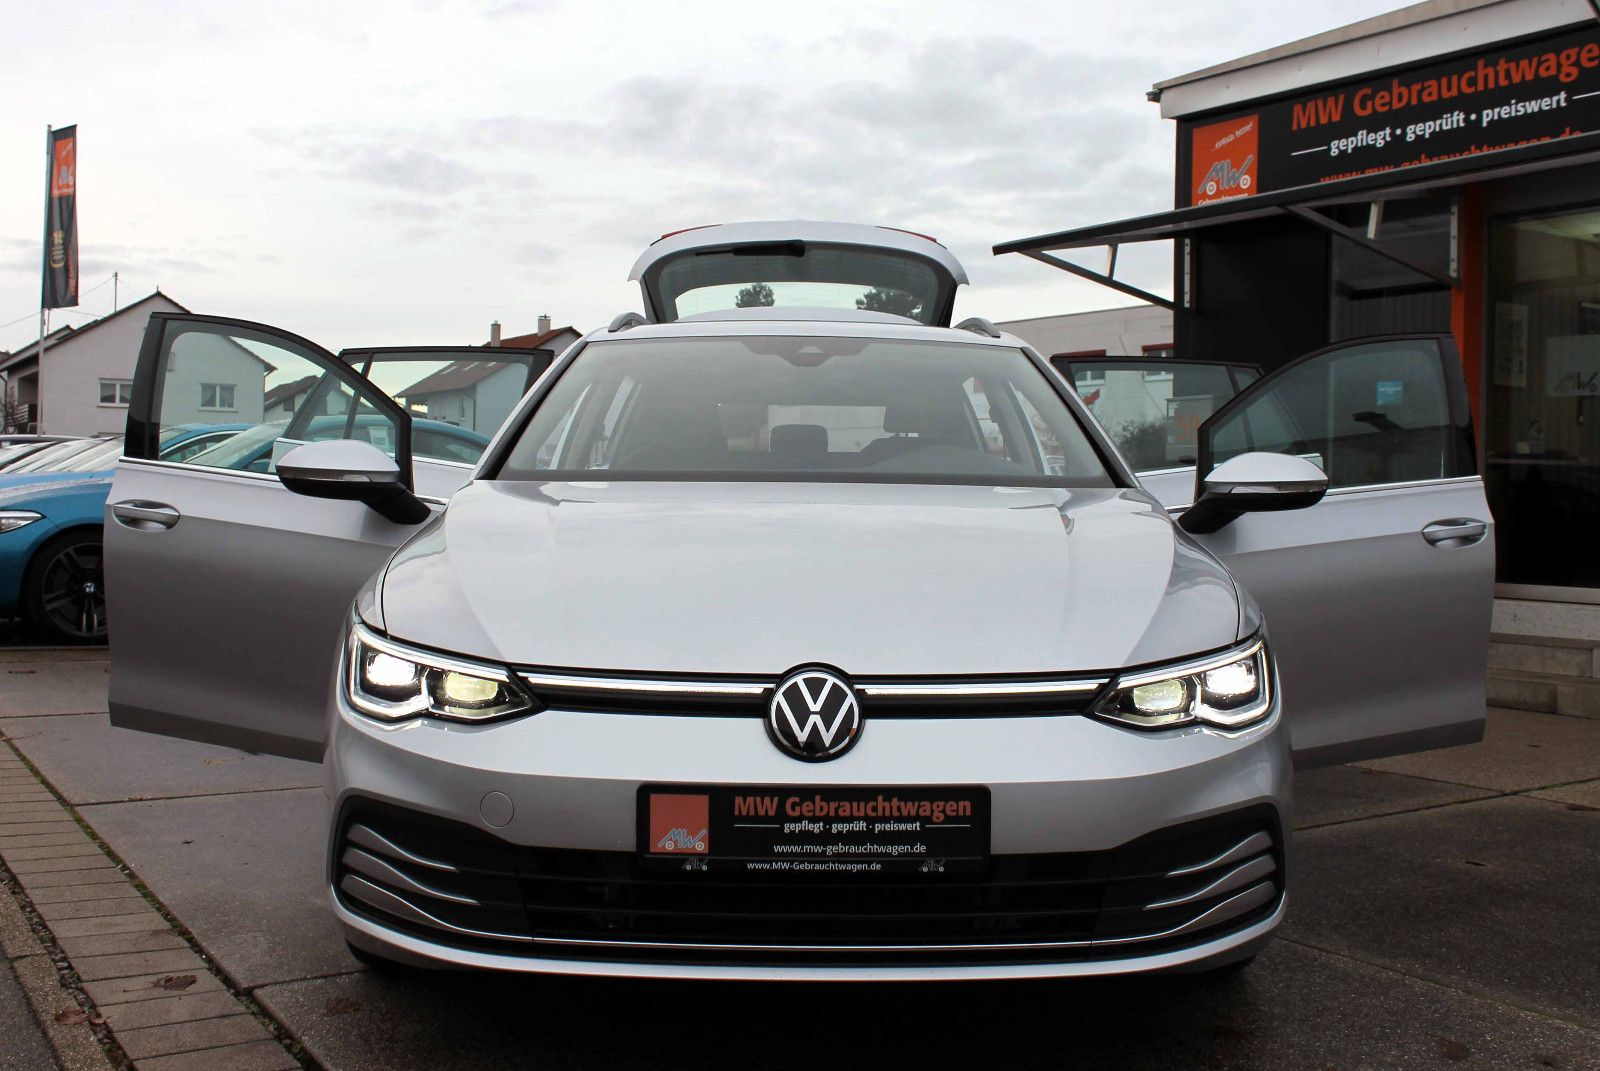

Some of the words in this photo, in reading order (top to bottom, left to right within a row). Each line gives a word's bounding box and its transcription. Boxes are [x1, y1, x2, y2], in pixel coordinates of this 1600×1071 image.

[1292, 94, 1345, 131] MW
[1353, 43, 1600, 116] Gebrauchtwage
[1330, 126, 1391, 156] gepflegt
[1406, 110, 1466, 141] geprüft
[1482, 90, 1568, 127] preiswert
[734, 796, 779, 817] MW
[785, 795, 972, 823] Gebrauchtwagen
[783, 821, 824, 834] gepflegt
[831, 821, 867, 834] geprüft
[874, 821, 921, 834] preiswert
[773, 843, 927, 856] www.mw-gebrauchtwagen.de
[746, 861, 882, 873] www.MW-Gebrauchtwagen.de
